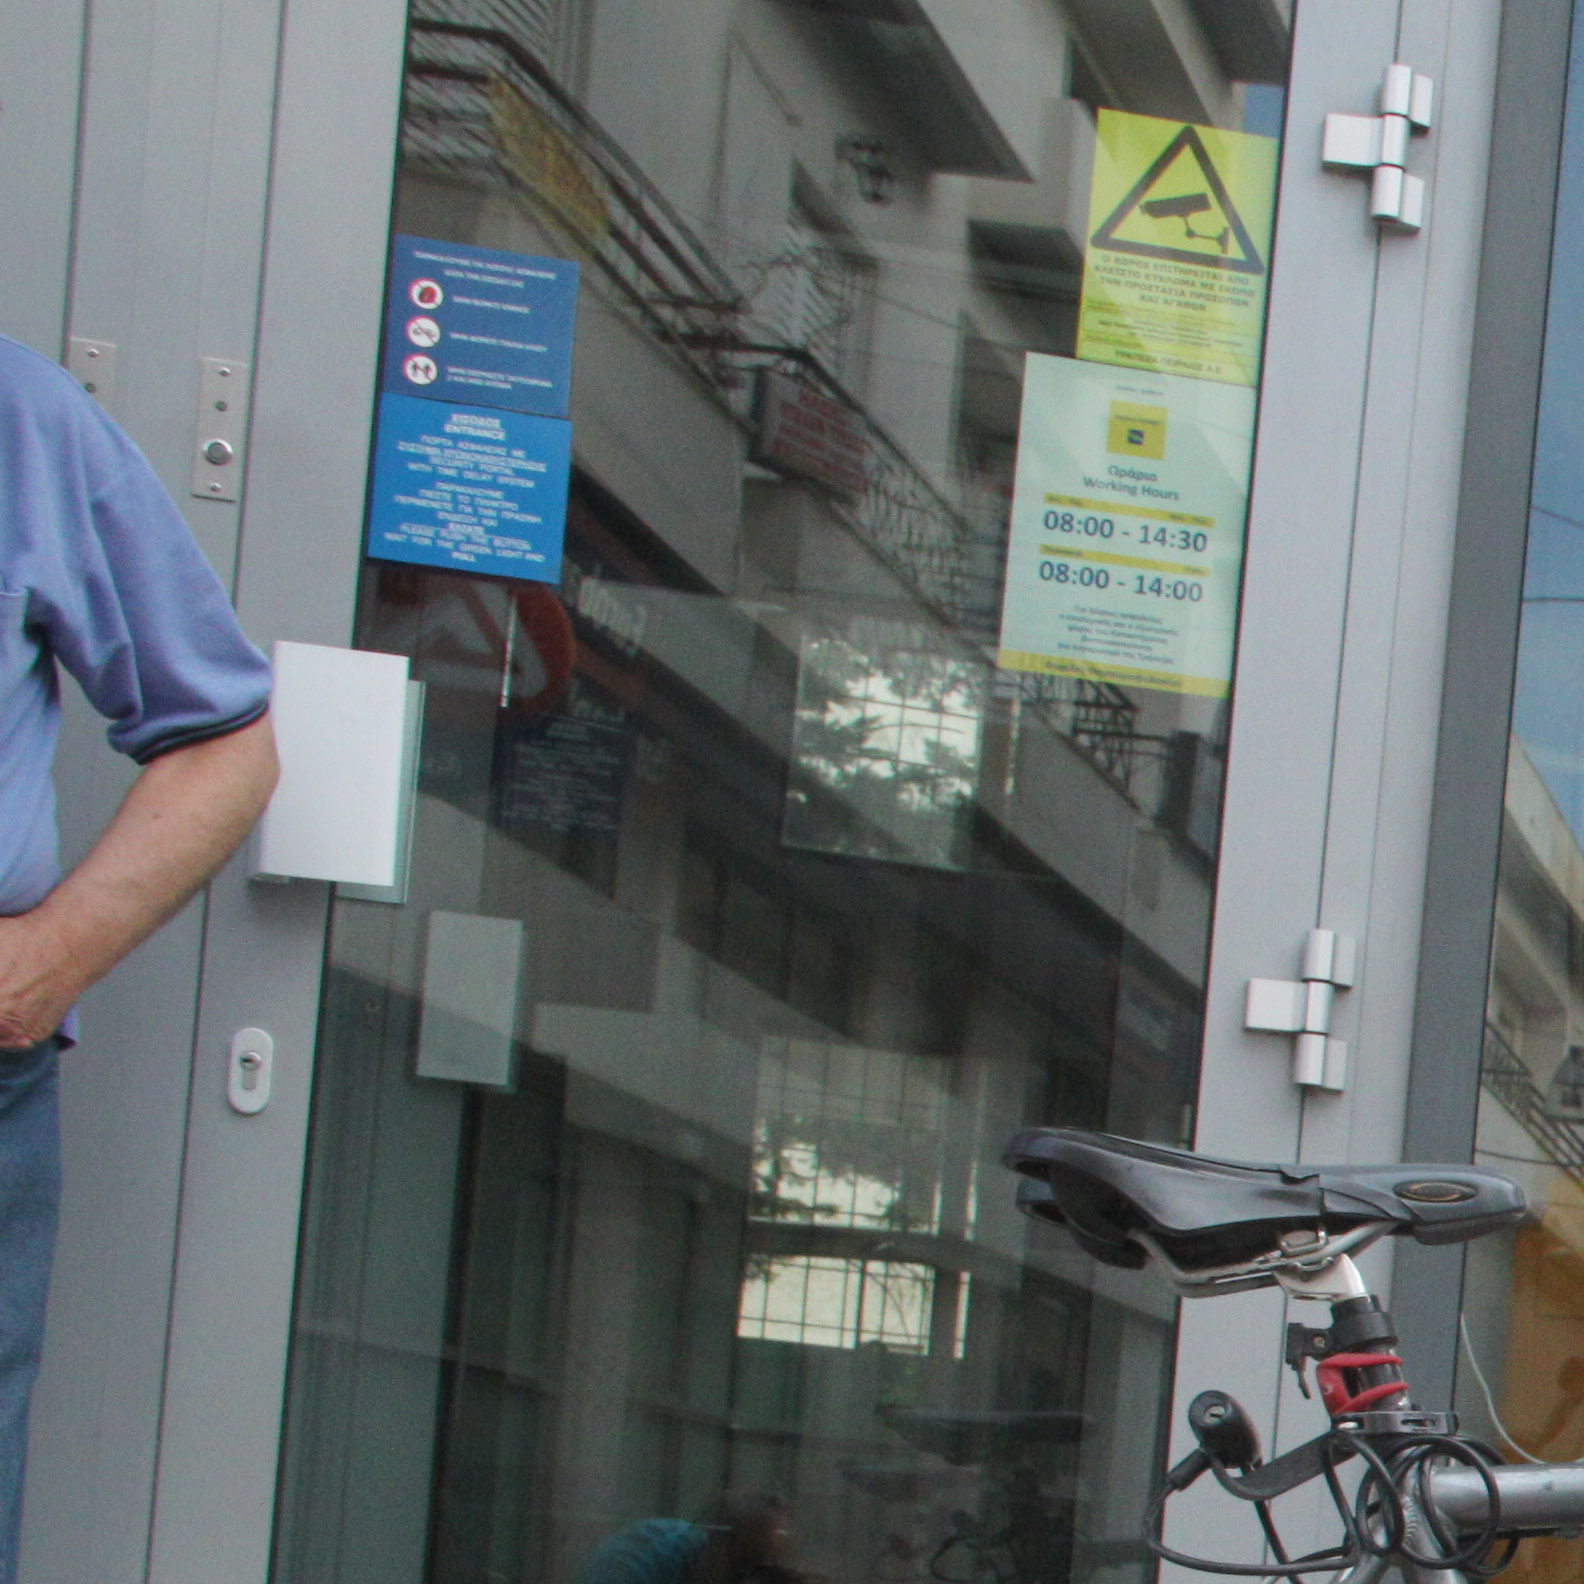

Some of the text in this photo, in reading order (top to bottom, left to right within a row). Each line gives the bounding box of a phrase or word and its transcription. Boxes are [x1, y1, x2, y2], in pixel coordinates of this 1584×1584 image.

[1083, 475, 1181, 501] Working Hours
[1043, 509, 1115, 539] 08:00
[1139, 524, 1208, 553] 14:30
[1039, 560, 1111, 589] 08:00
[1134, 574, 1203, 602] 14:00
